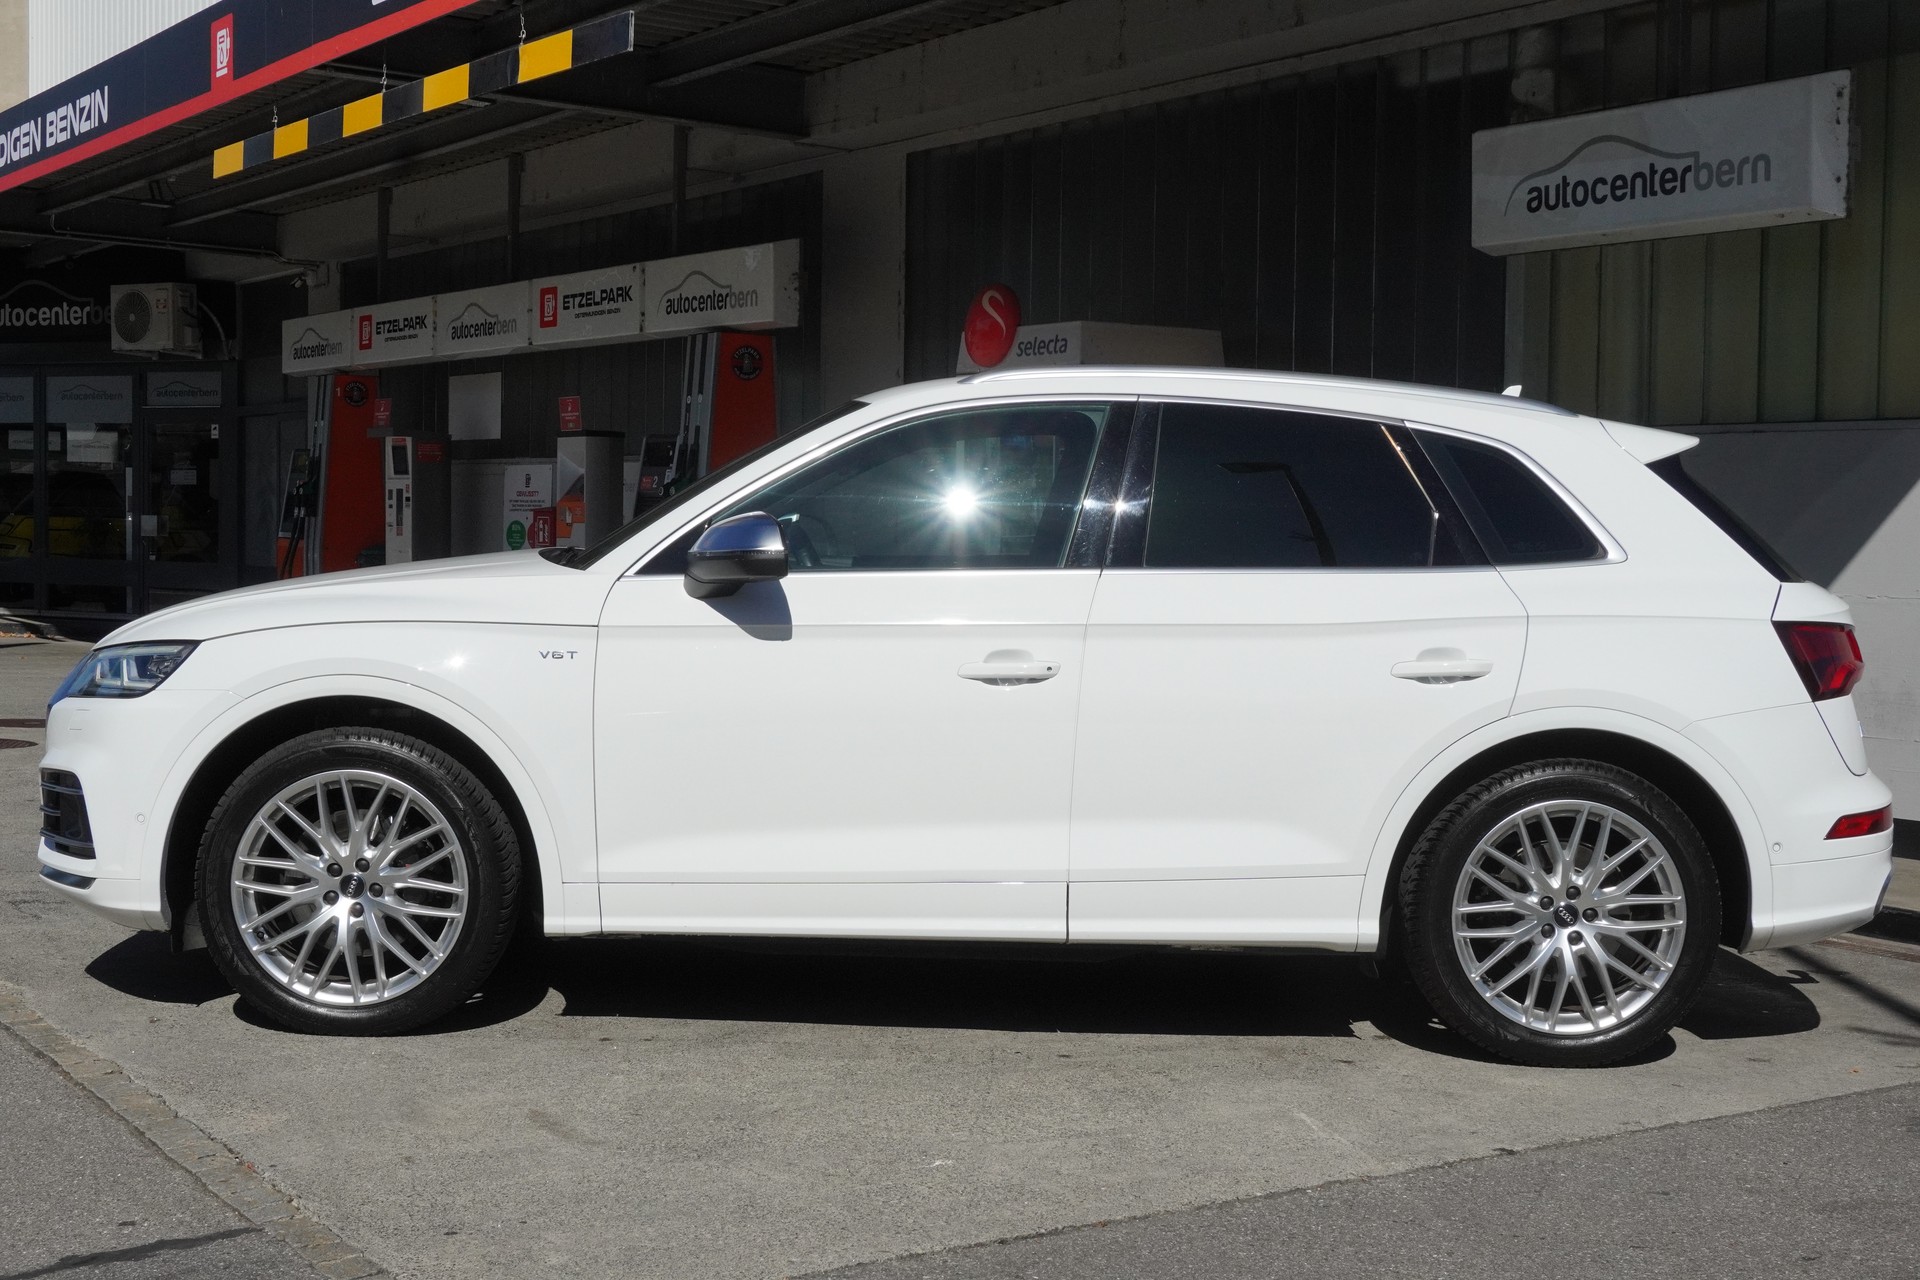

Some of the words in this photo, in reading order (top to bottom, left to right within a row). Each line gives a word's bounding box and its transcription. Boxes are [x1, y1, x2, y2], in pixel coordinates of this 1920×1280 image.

[46, 86, 109, 148] BENZIN
[1526, 152, 1771, 214] autocenterbern
[563, 285, 633, 311] ETZELPARK
[665, 287, 758, 316] autocenterbern
[376, 315, 427, 335] ETZELPARK
[451, 317, 517, 341] autocenterbern
[293, 341, 343, 360] autocenterbern
[1016, 334, 1068, 357] selecta
[335, 387, 341, 397] 1
[652, 475, 658, 488] 2
